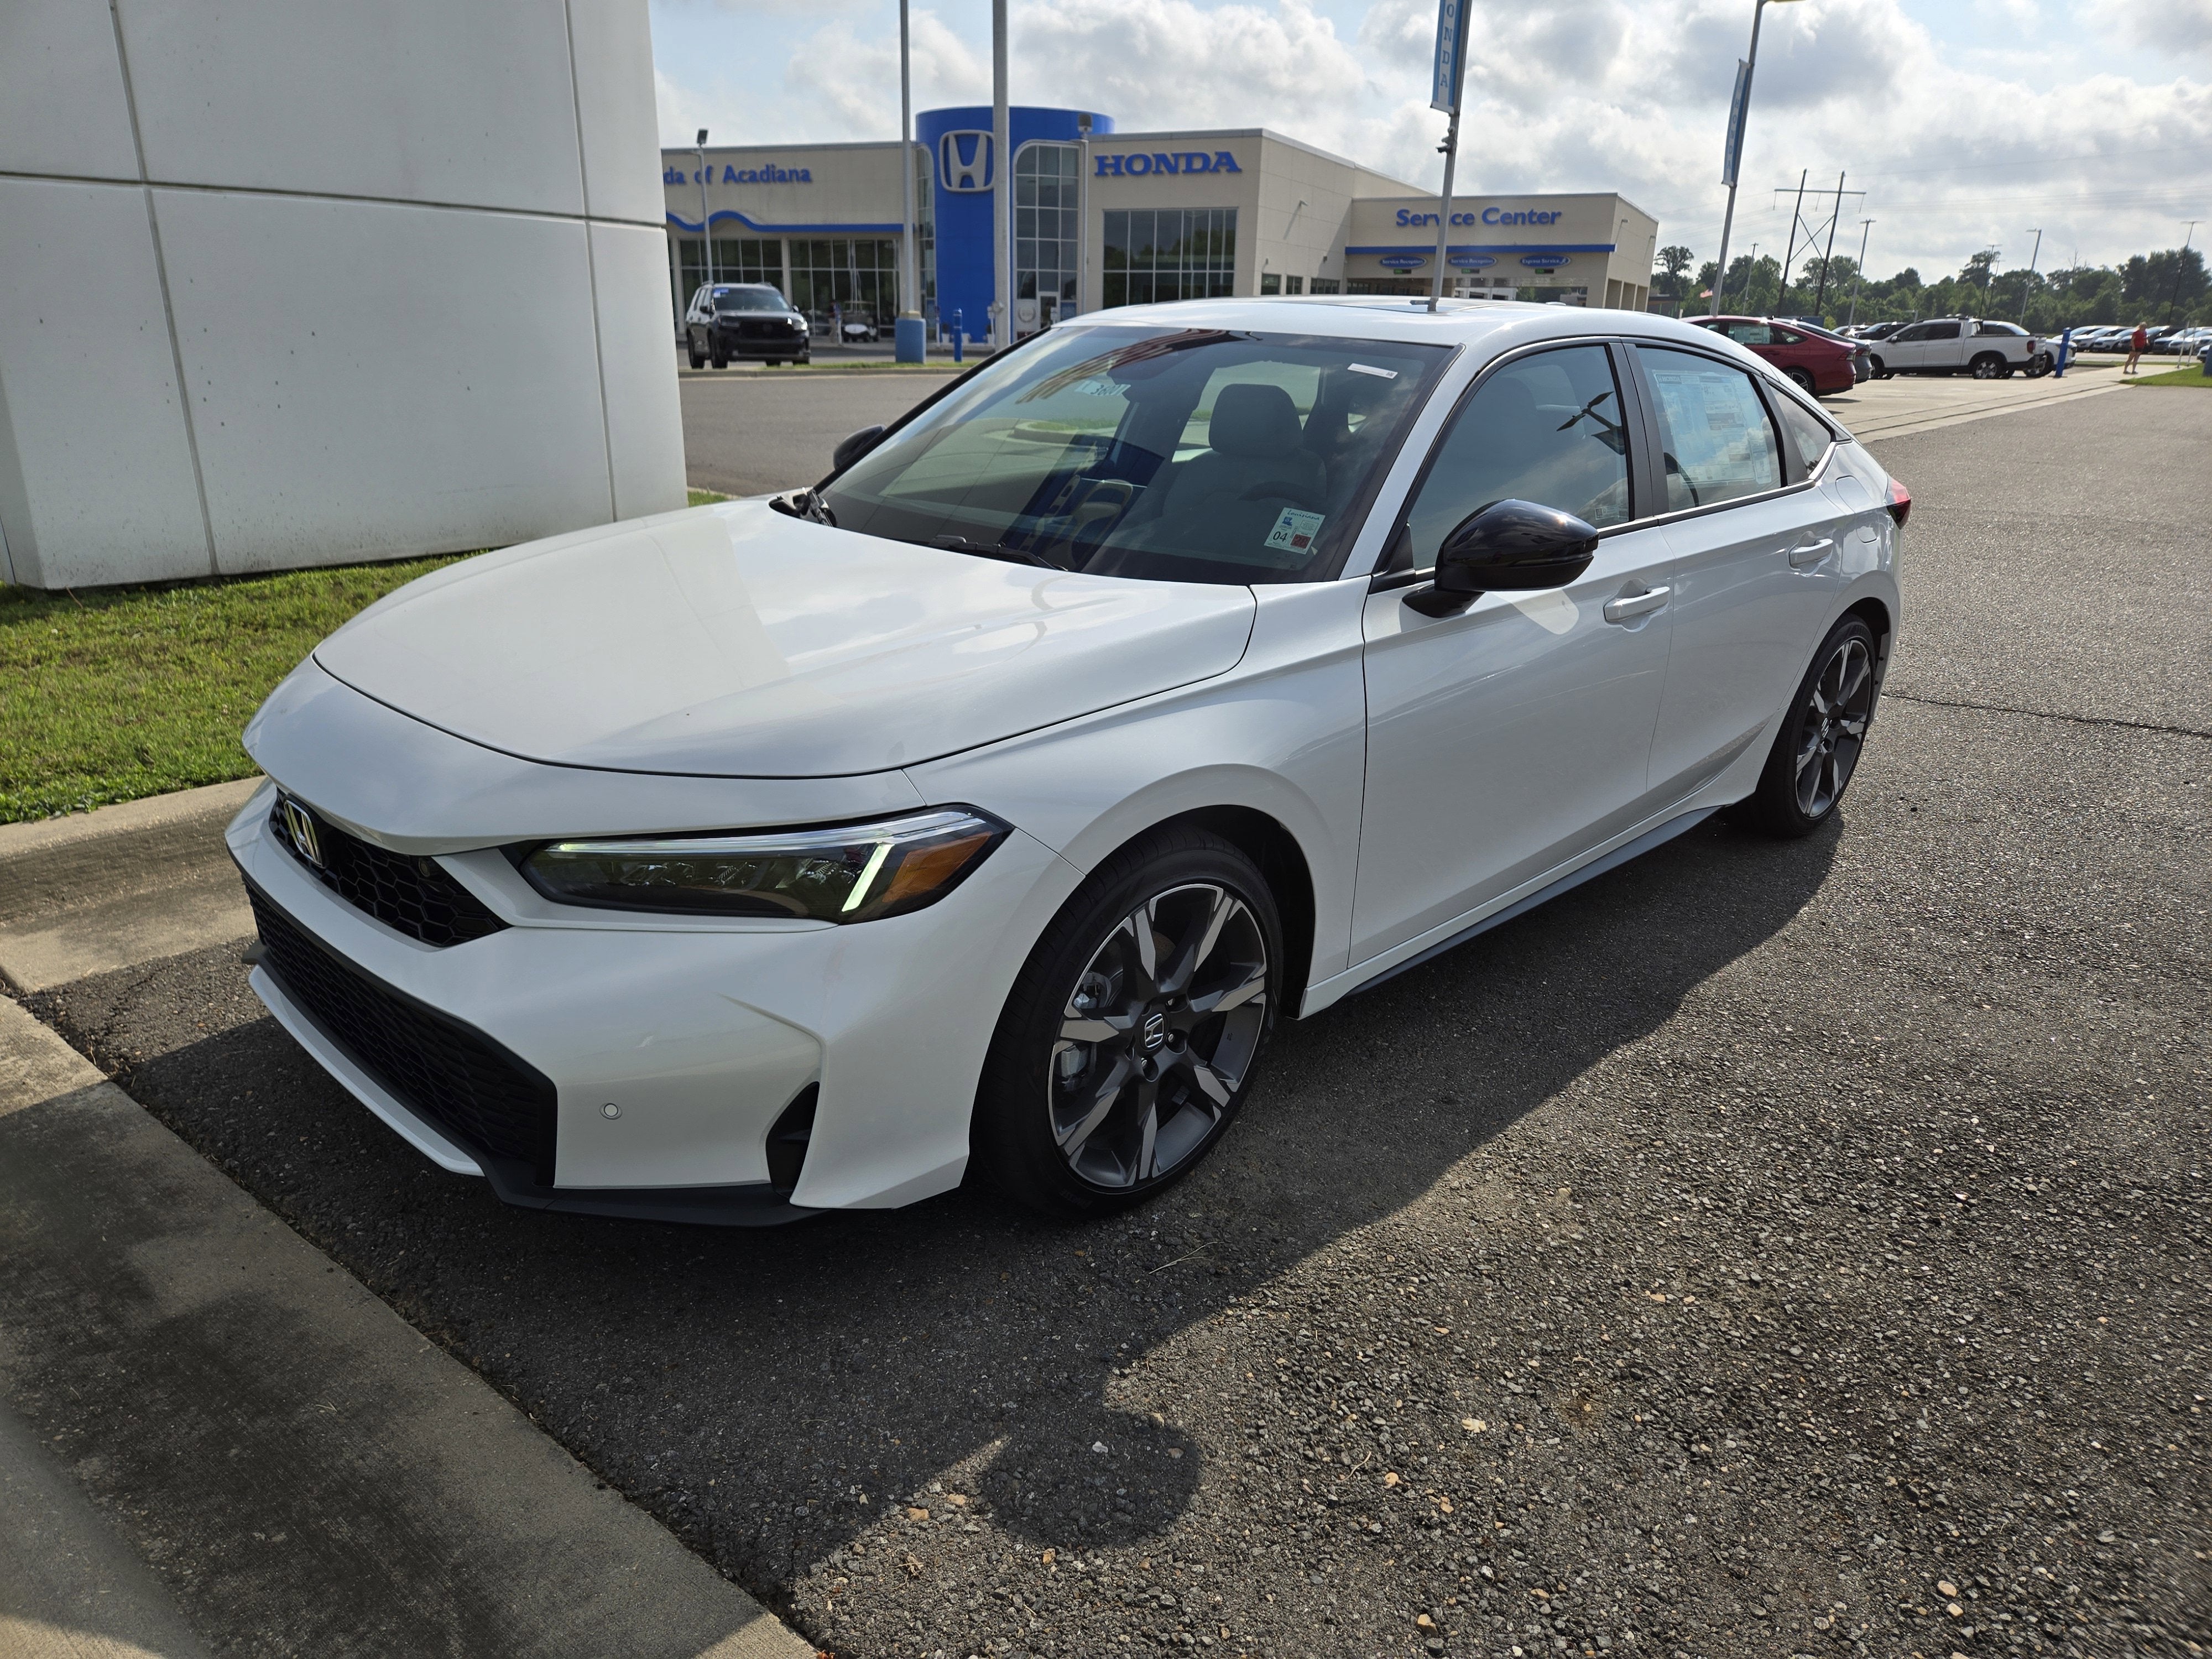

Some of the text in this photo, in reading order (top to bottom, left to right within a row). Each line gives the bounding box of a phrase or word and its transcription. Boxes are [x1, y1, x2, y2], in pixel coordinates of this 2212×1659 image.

[1094, 151, 1242, 176] HONDA
[723, 164, 812, 184] Acadiana
[1396, 207, 1562, 227] Serce Center
[1287, 509, 1320, 520] Louisiana
[1273, 531, 1288, 542] 04
